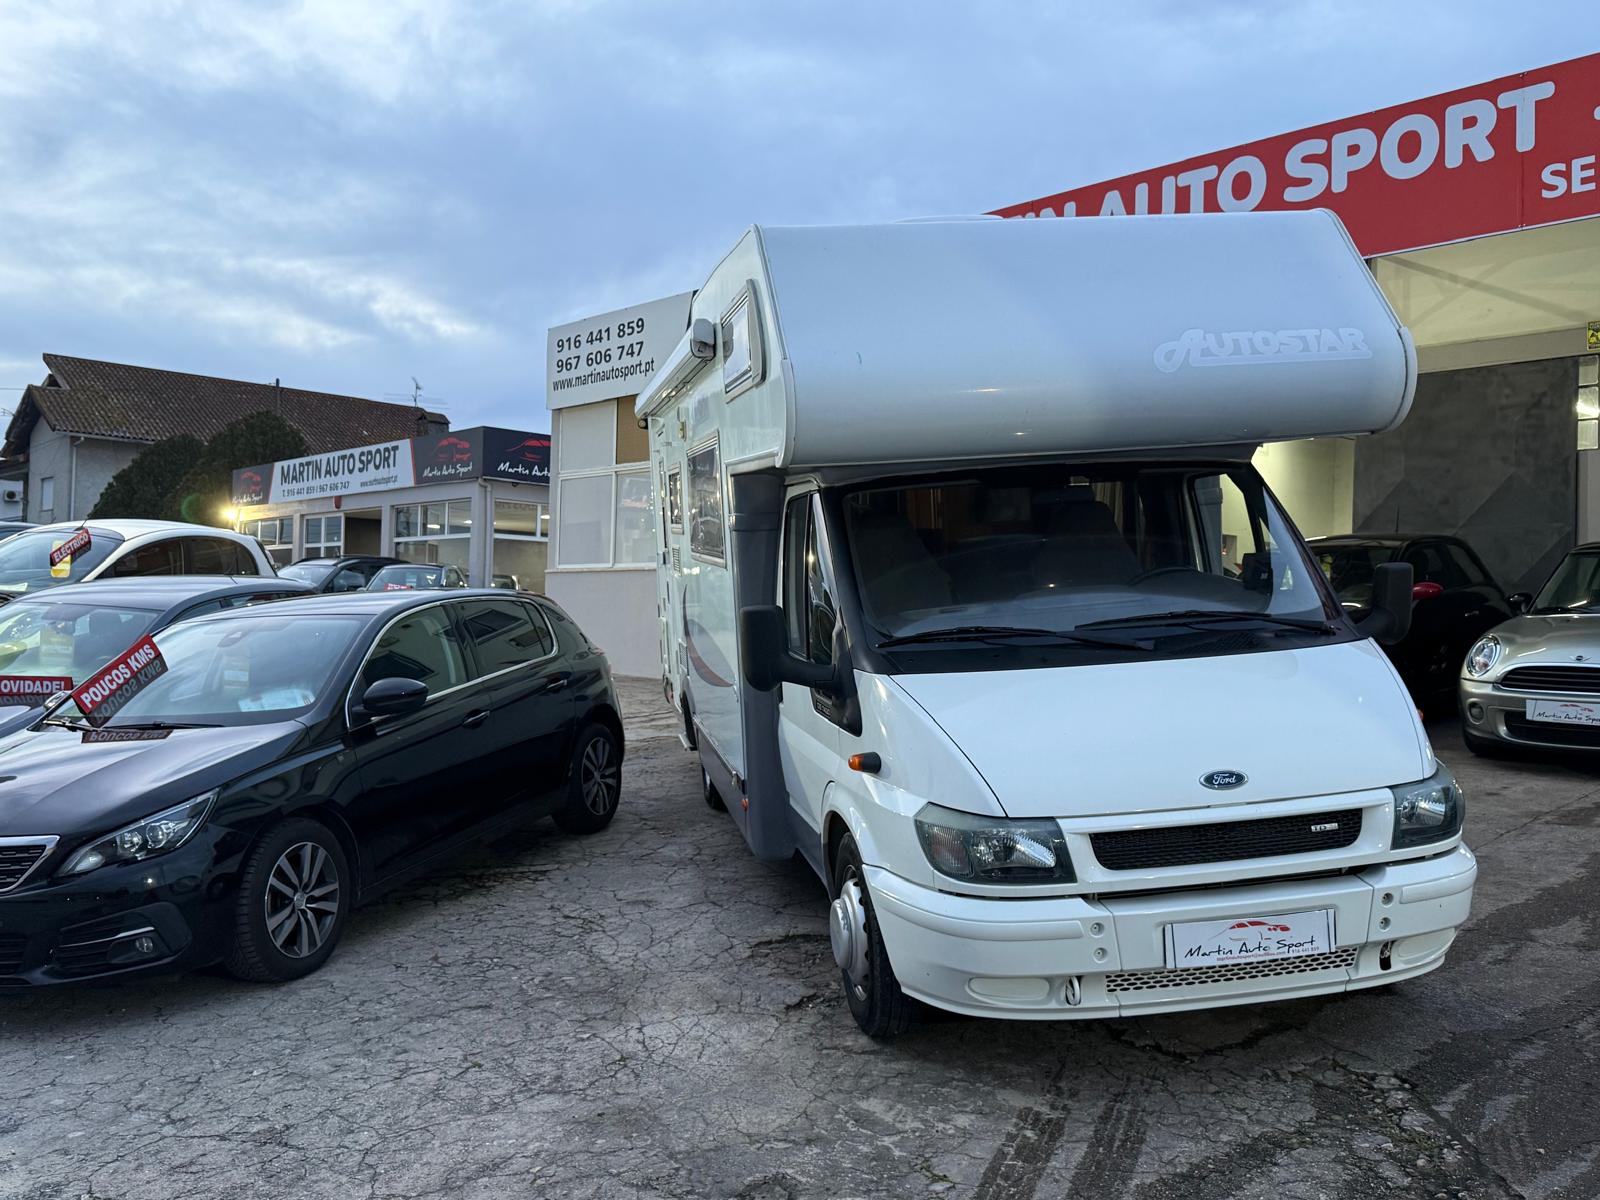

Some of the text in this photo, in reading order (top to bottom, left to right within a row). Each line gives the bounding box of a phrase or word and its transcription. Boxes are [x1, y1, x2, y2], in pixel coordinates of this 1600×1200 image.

[1283, 81, 1556, 203] SPORT
[1541, 155, 1597, 198] SE
[557, 317, 645, 353] 916 441 859
[1153, 328, 1371, 373] AUTOSTAR
[553, 357, 655, 391] www.martinautosport.pt
[556, 341, 645, 373] 967 606 747
[281, 445, 400, 486] MARTIN AUTO SPORT
[422, 461, 473, 478] Martin Auto Sport
[497, 461, 530, 475] Martin
[80, 643, 156, 708] POUCOS KMS
[1536, 711, 1562, 719] Martin
[1212, 773, 1236, 785] Ford
[1184, 935, 1316, 958] Martin Auto Sport
